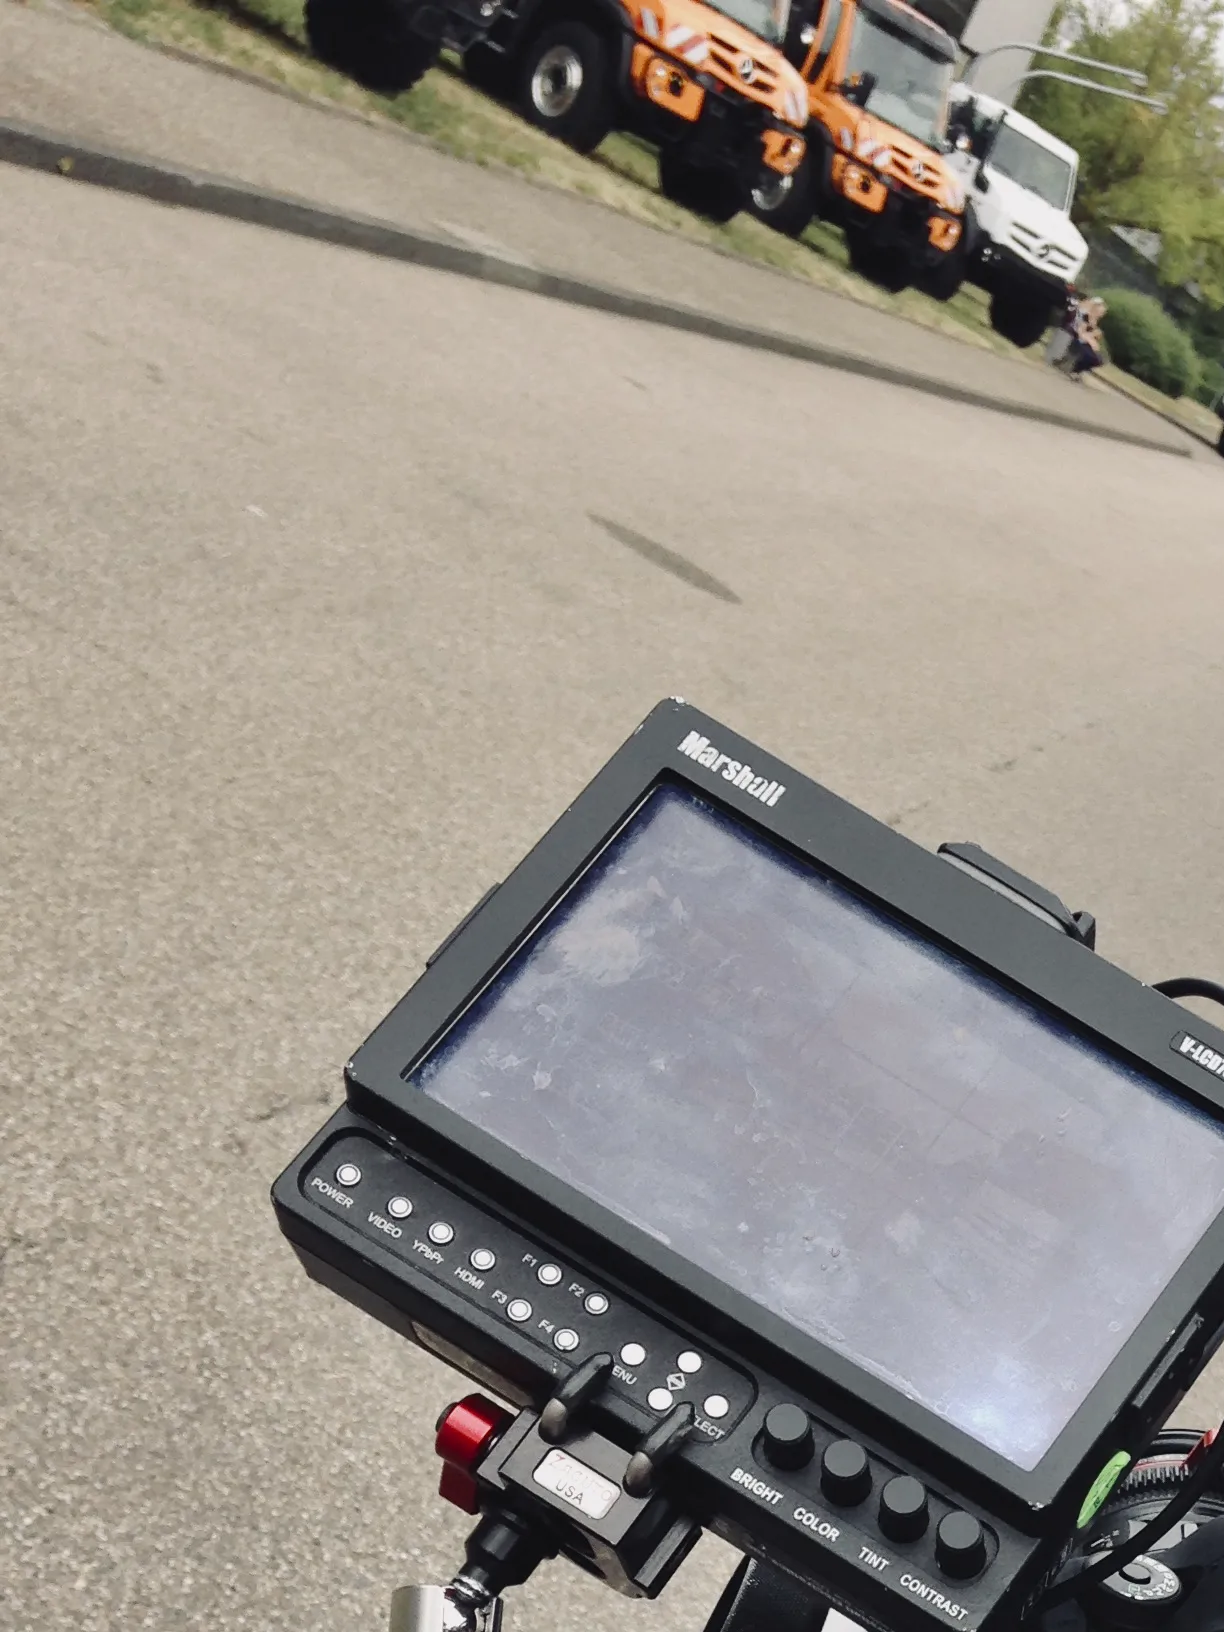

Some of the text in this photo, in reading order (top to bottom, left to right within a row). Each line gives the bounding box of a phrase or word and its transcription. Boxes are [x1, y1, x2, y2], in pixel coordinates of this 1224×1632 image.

[677, 730, 787, 807] Marshall
[310, 1177, 353, 1209] POWER
[367, 1212, 402, 1239] VIDEO
[412, 1239, 444, 1265] YPbPr
[522, 1253, 538, 1267] F1
[454, 1267, 485, 1290] HDMI
[568, 1282, 584, 1298] F2
[491, 1289, 508, 1304] F3
[537, 1318, 555, 1333] F4
[611, 1365, 638, 1385] ENU
[694, 1416, 725, 1439] LECT
[555, 1480, 584, 1505] USA
[730, 1467, 784, 1505] BRIGHT
[793, 1507, 840, 1543] COLOR
[858, 1546, 889, 1572] TINT
[900, 1573, 968, 1621] CONTRAST
